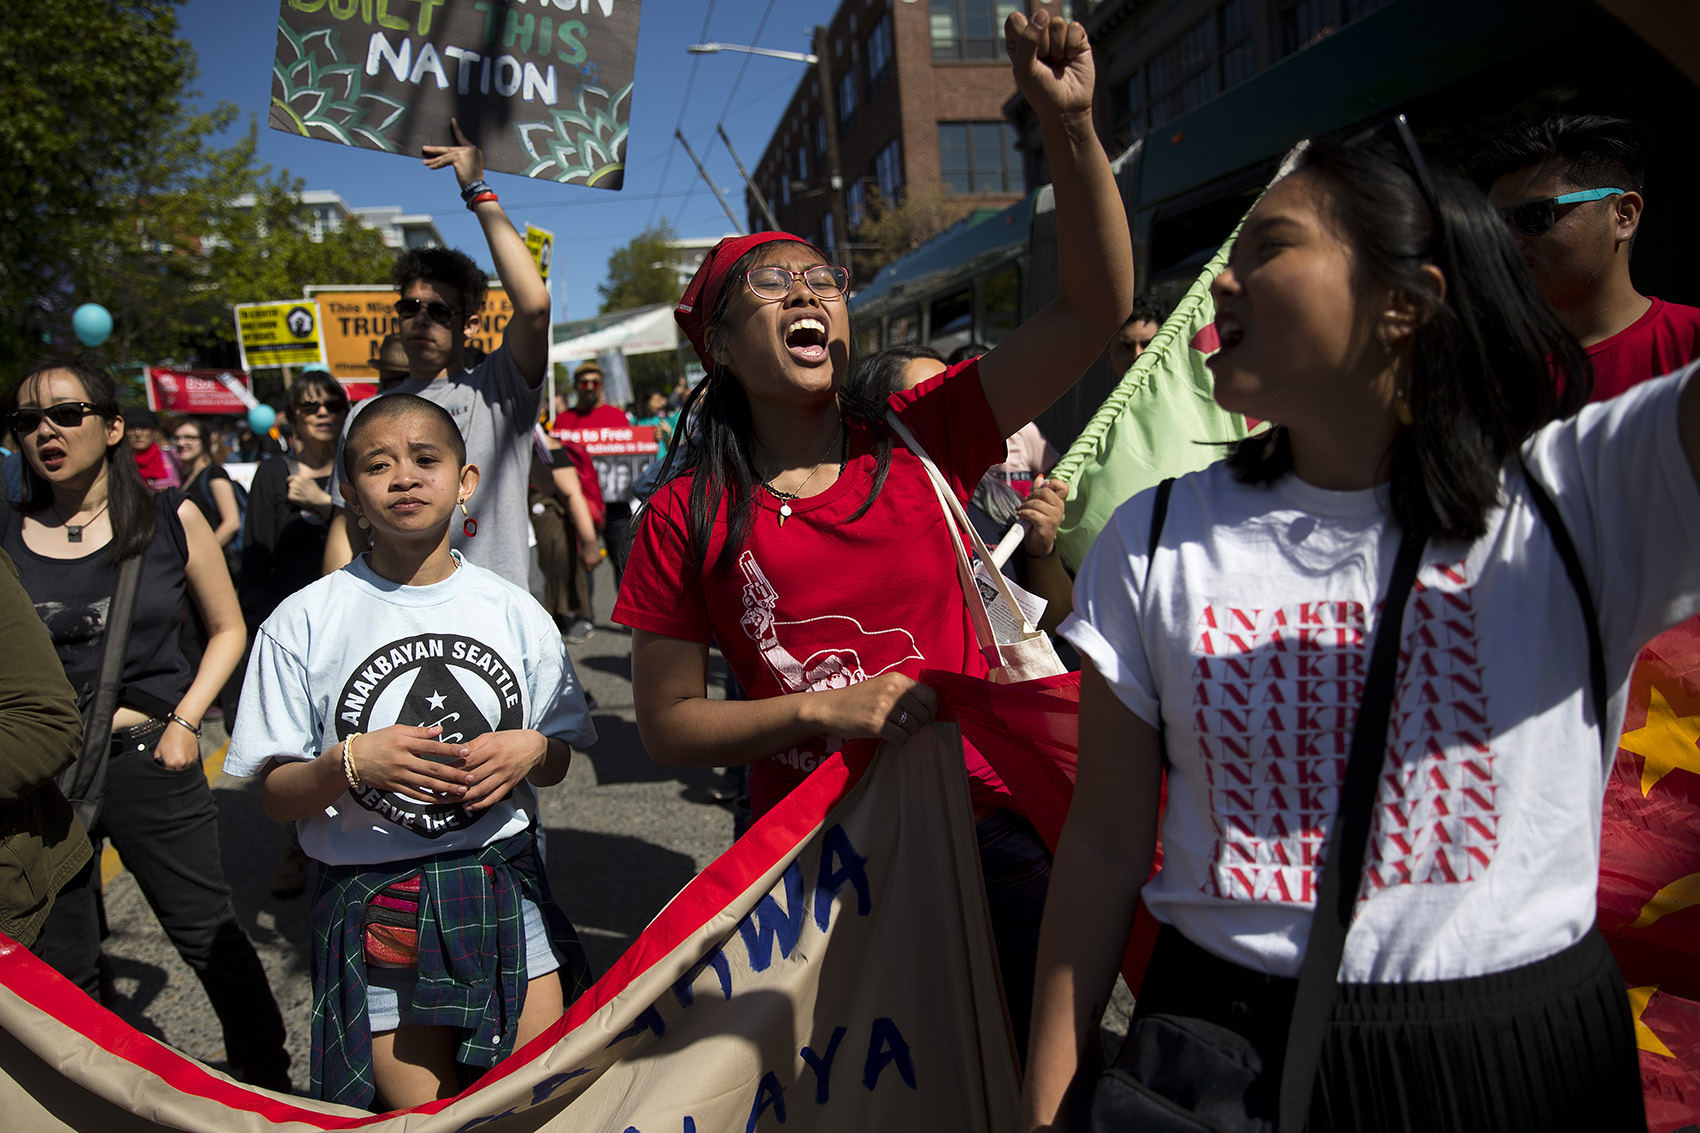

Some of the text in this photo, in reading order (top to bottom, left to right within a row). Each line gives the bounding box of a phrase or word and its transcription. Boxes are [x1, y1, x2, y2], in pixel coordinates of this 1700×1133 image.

[474, 1, 589, 65] THIS
[365, 31, 559, 106] NATION
[328, 302, 361, 314] This
[581, 429, 600, 443] to
[600, 427, 634, 442] Free
[341, 638, 519, 727] ANAKBAYAN SEATTLE
[422, 808, 460, 833] THE
